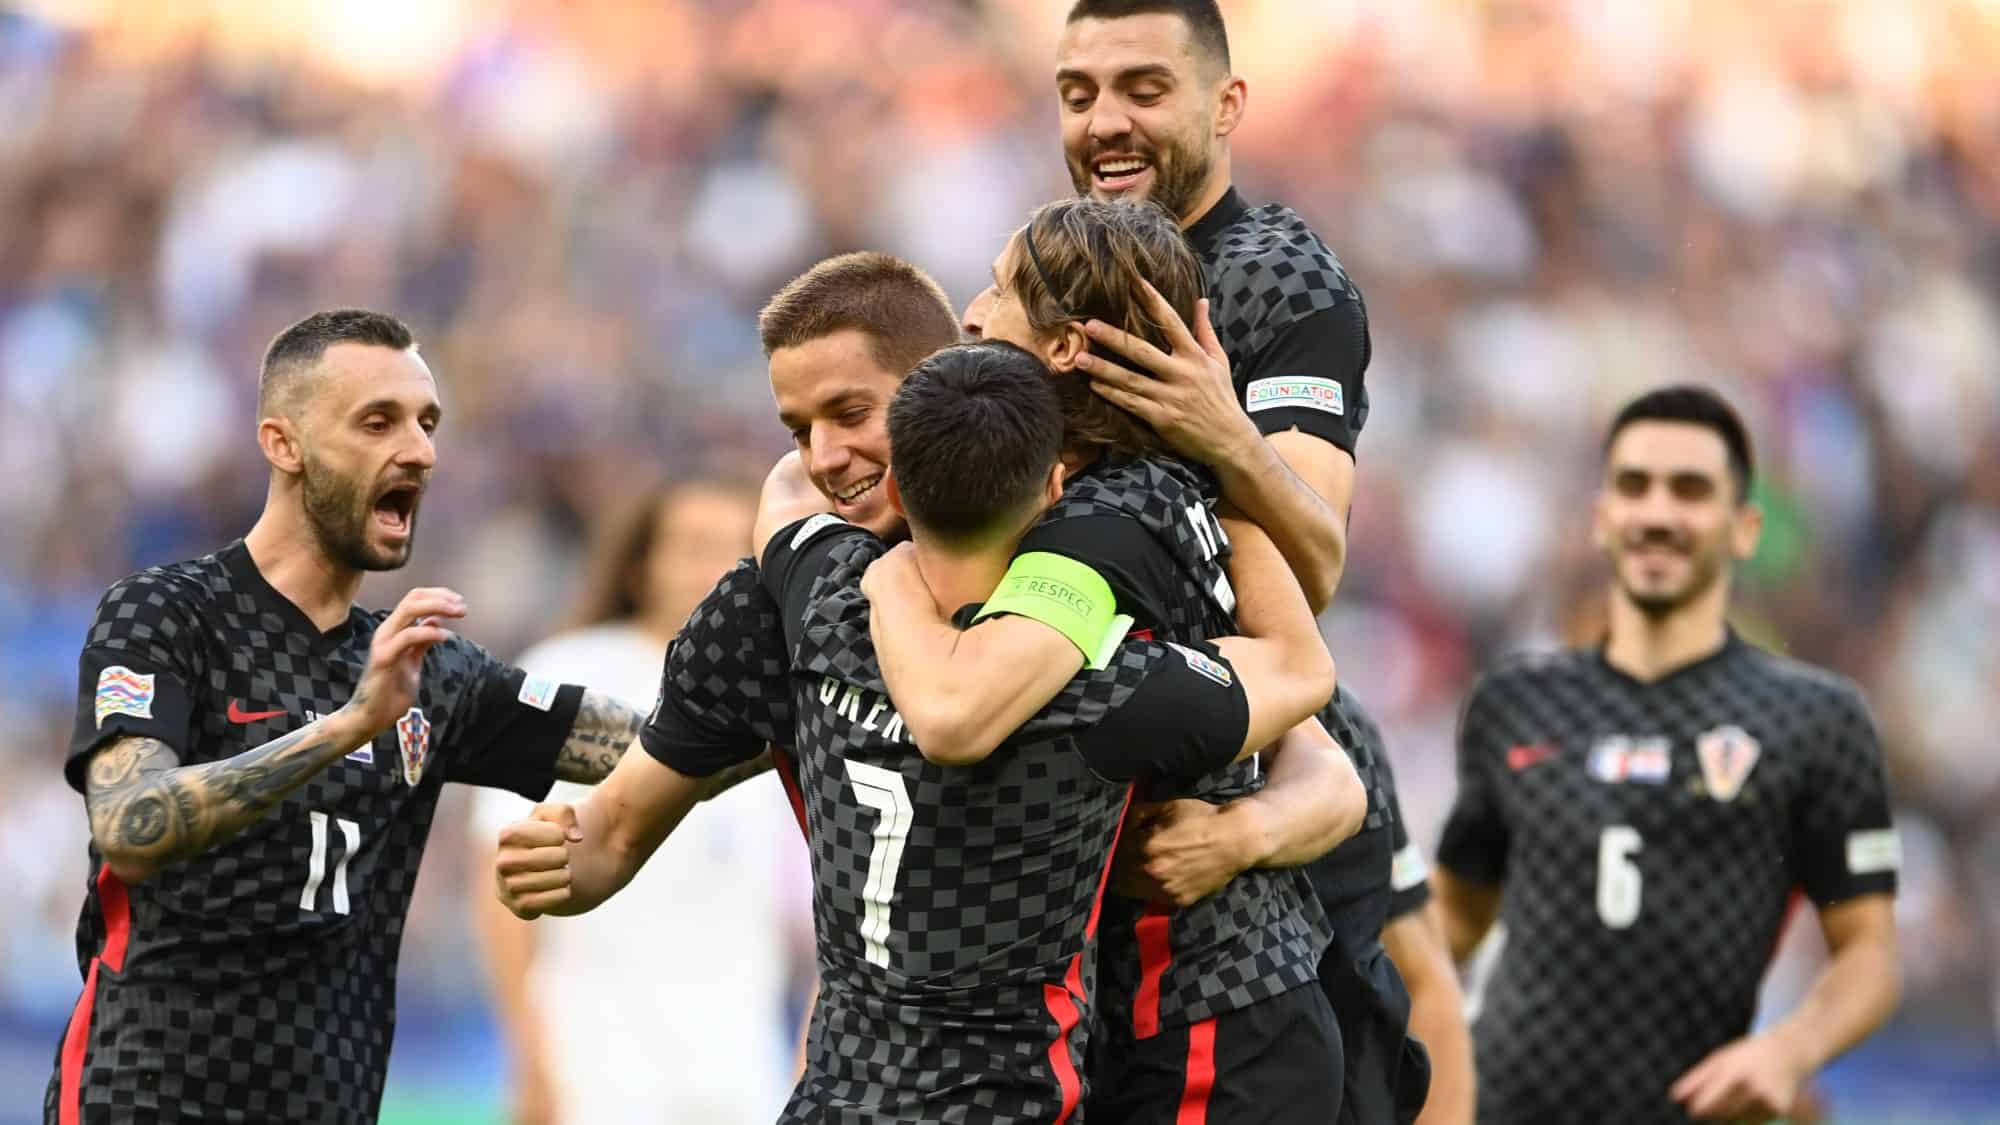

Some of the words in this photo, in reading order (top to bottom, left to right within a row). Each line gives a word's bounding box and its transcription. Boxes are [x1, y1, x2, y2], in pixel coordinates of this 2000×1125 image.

[1250, 383, 1341, 401] FOUNDATION
[1027, 580, 1094, 617] RESPECT
[299, 810, 360, 916] 11
[843, 758, 914, 970] 7
[1596, 825, 1643, 930] 6
